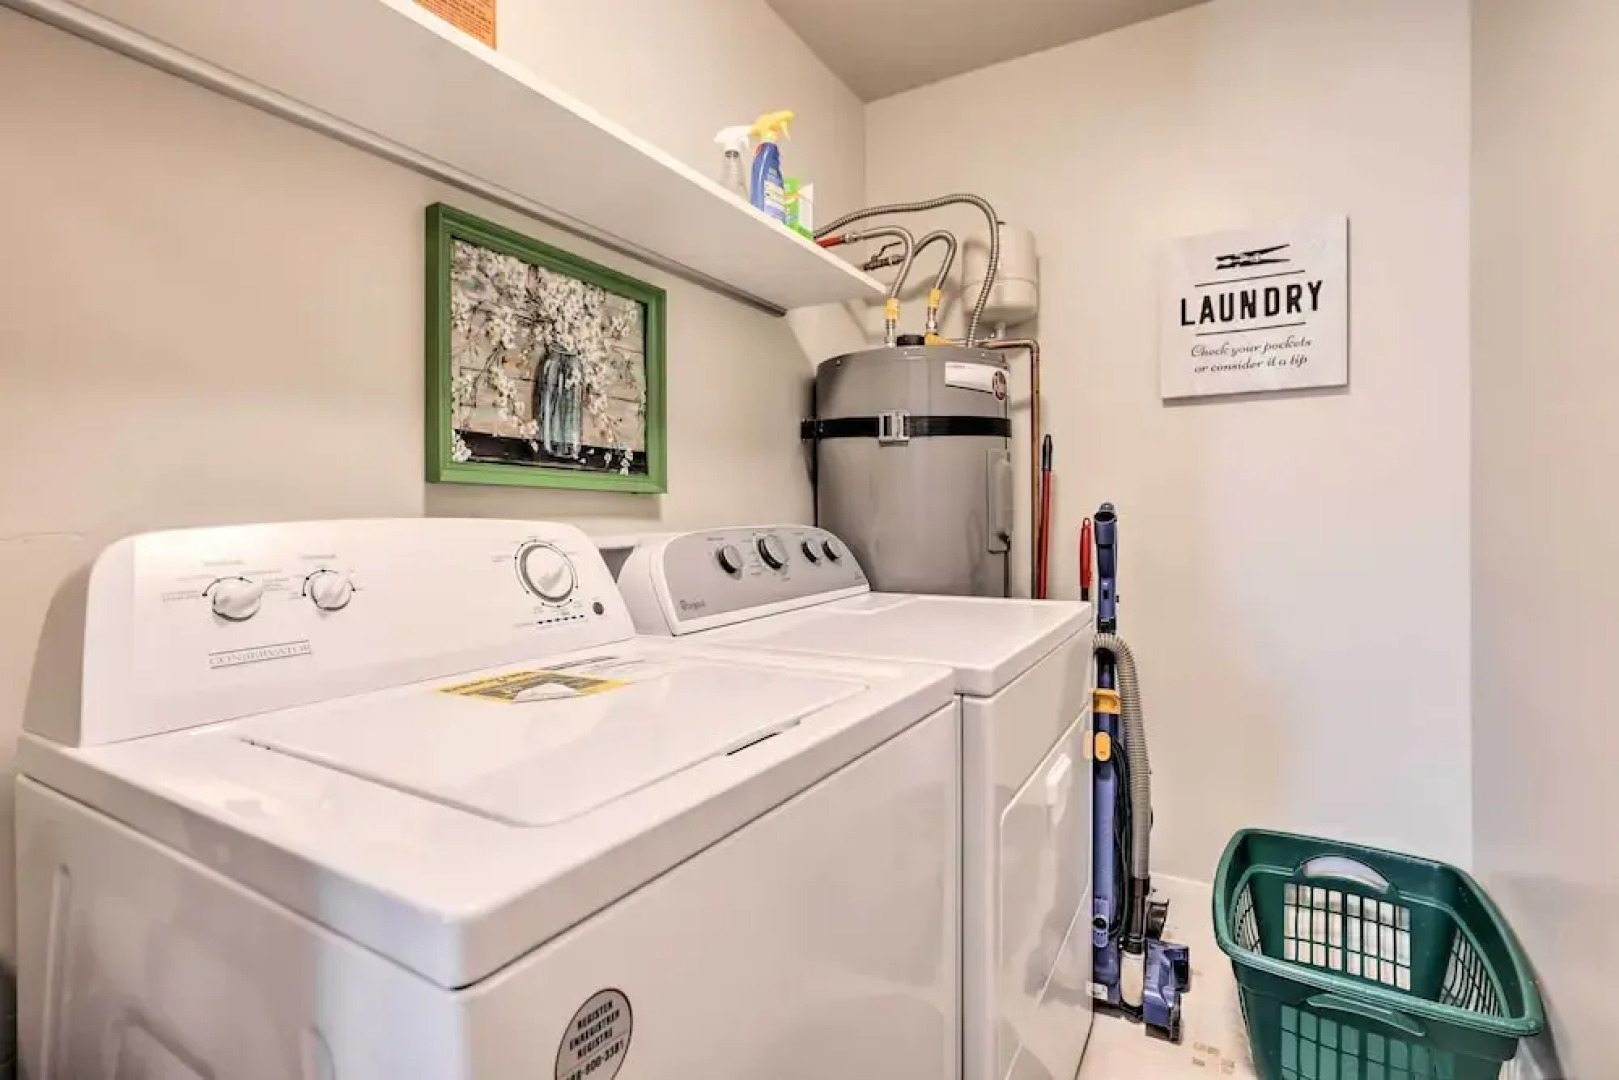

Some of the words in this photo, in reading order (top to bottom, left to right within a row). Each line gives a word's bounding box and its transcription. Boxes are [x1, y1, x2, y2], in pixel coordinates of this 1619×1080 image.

[1181, 279, 1323, 326] LAUNDRY
[1190, 342, 1230, 357] Check
[1231, 344, 1262, 357] your
[1263, 335, 1313, 355] pockets
[1194, 364, 1209, 373] or
[1210, 357, 1264, 373] consider
[1266, 356, 1276, 367] it
[1290, 354, 1308, 368] tip
[577, 999, 613, 1030] REGISTER
